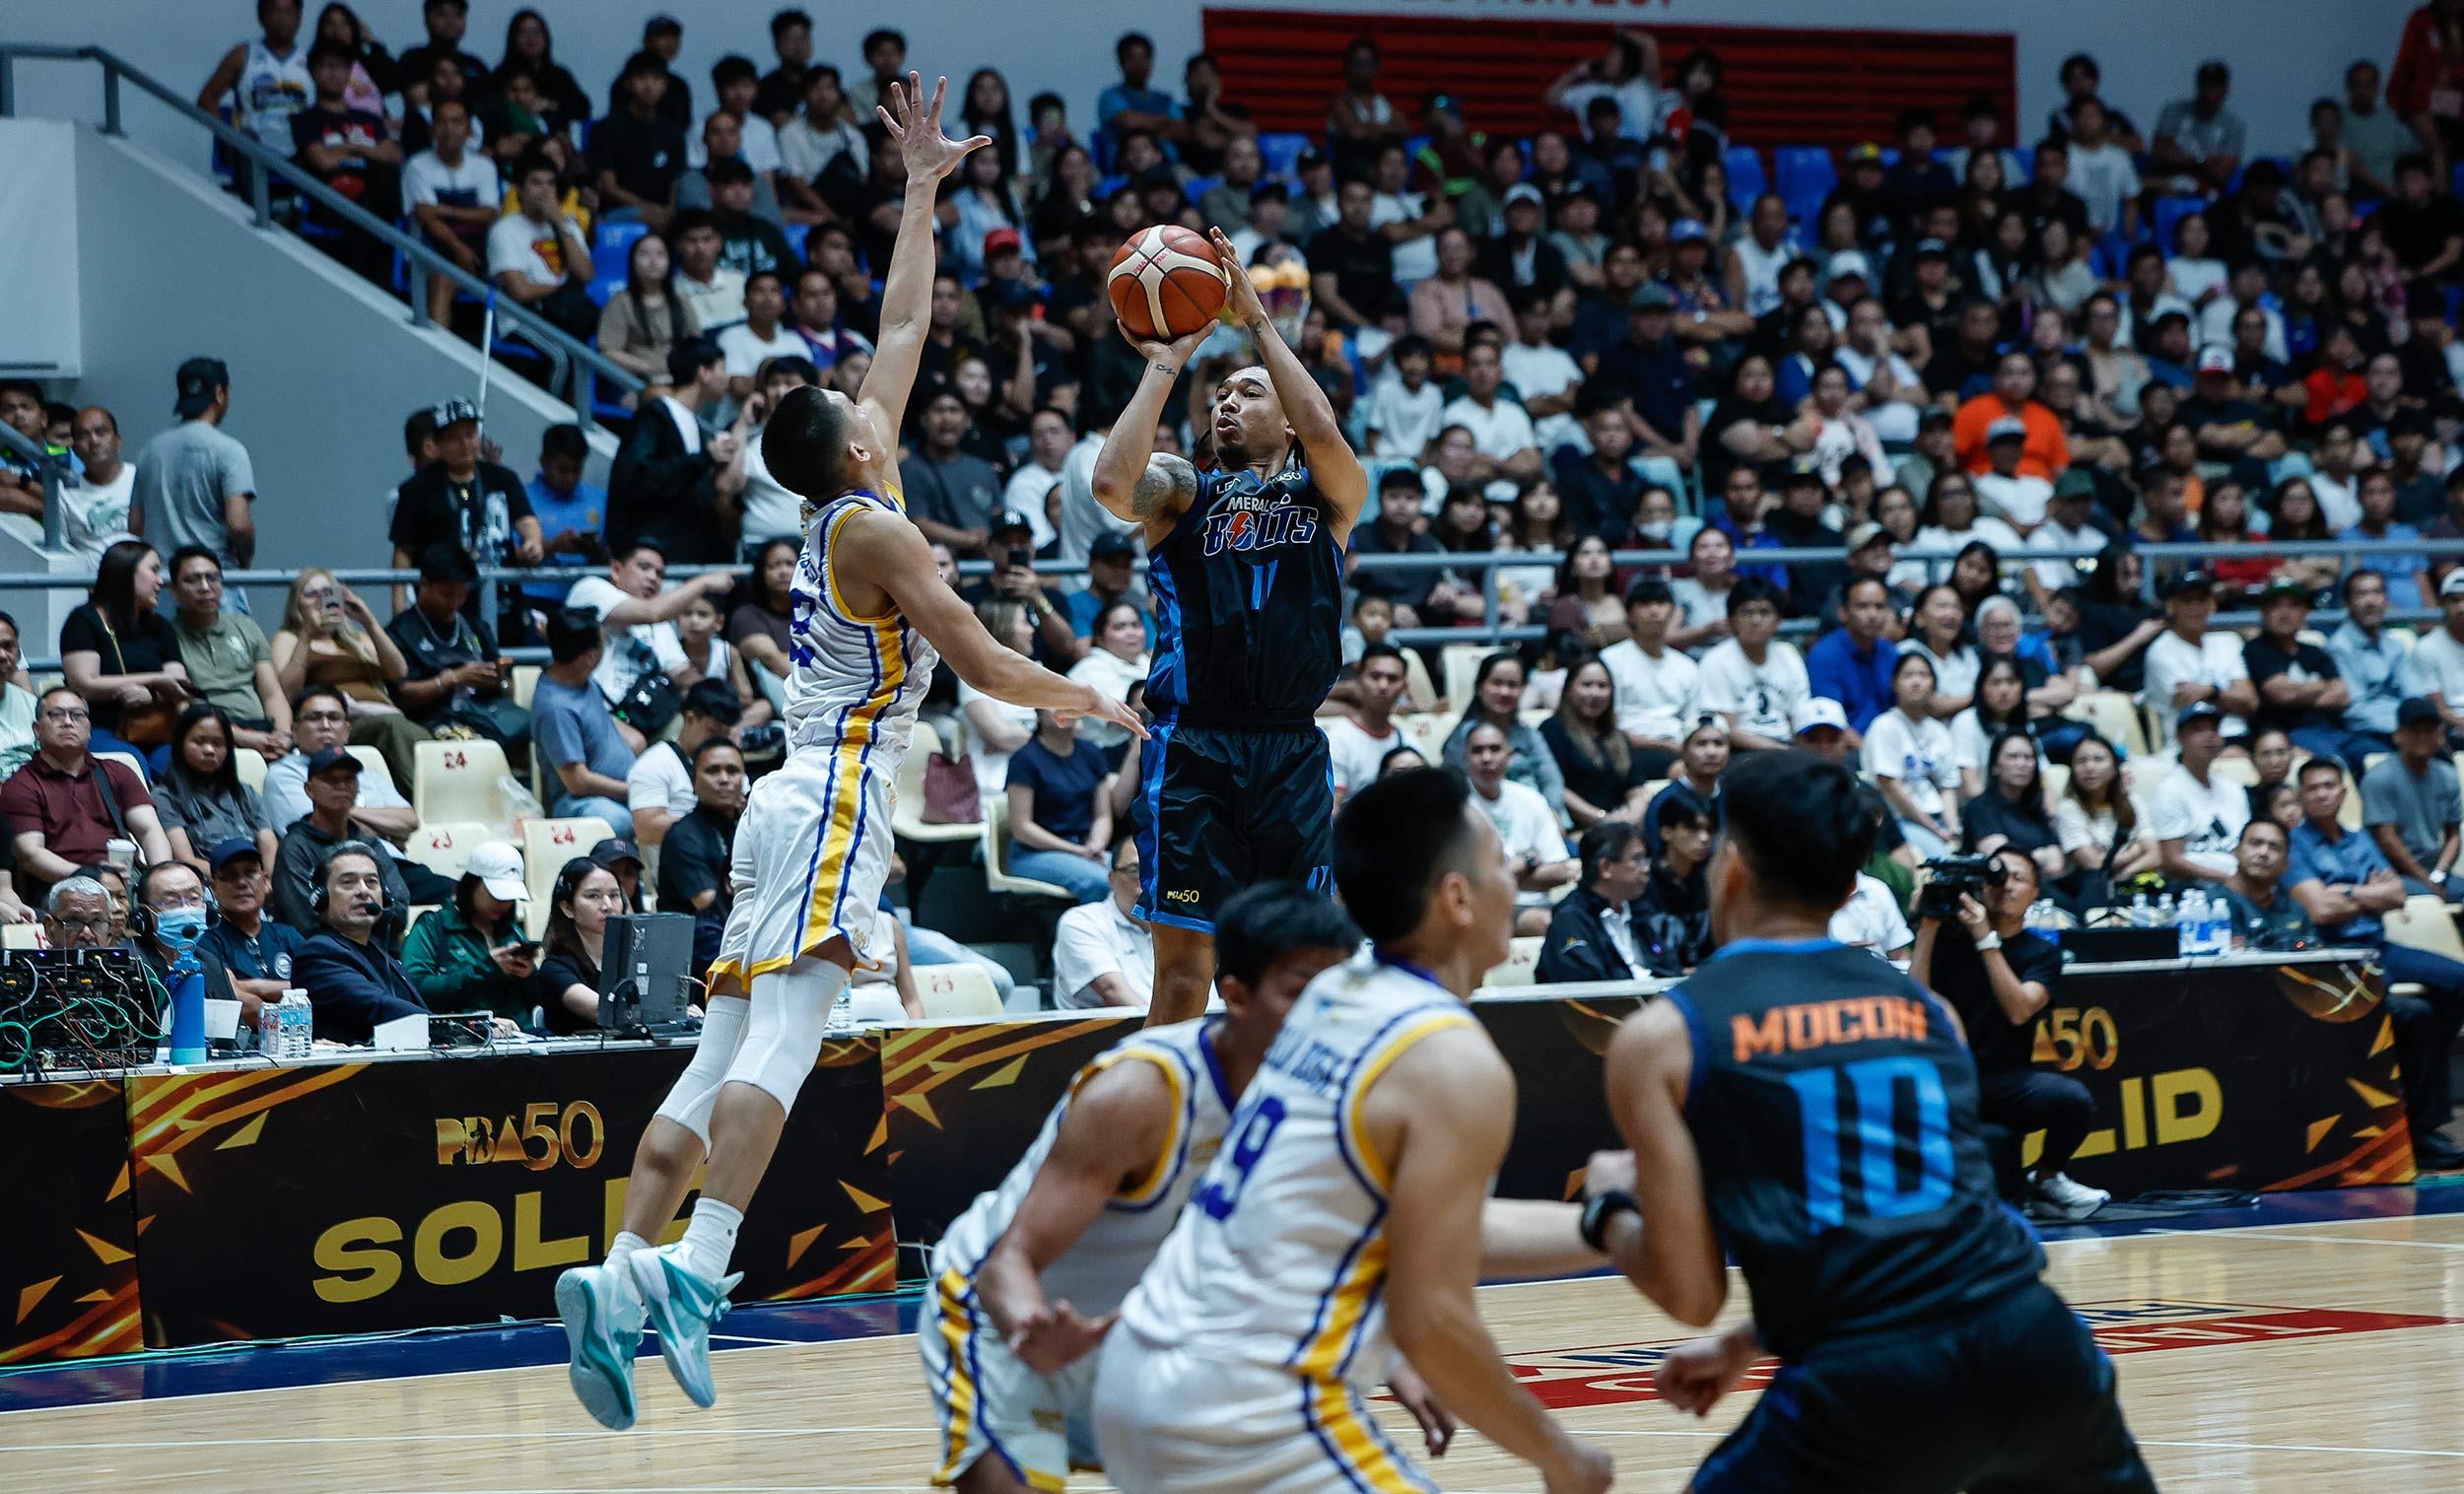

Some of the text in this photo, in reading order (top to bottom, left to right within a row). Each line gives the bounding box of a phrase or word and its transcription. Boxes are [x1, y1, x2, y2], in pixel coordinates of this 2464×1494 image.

[1203, 506, 1319, 556] BOLTS
[1732, 996, 1928, 1063] MOCON
[1785, 1055, 1955, 1234] 10
